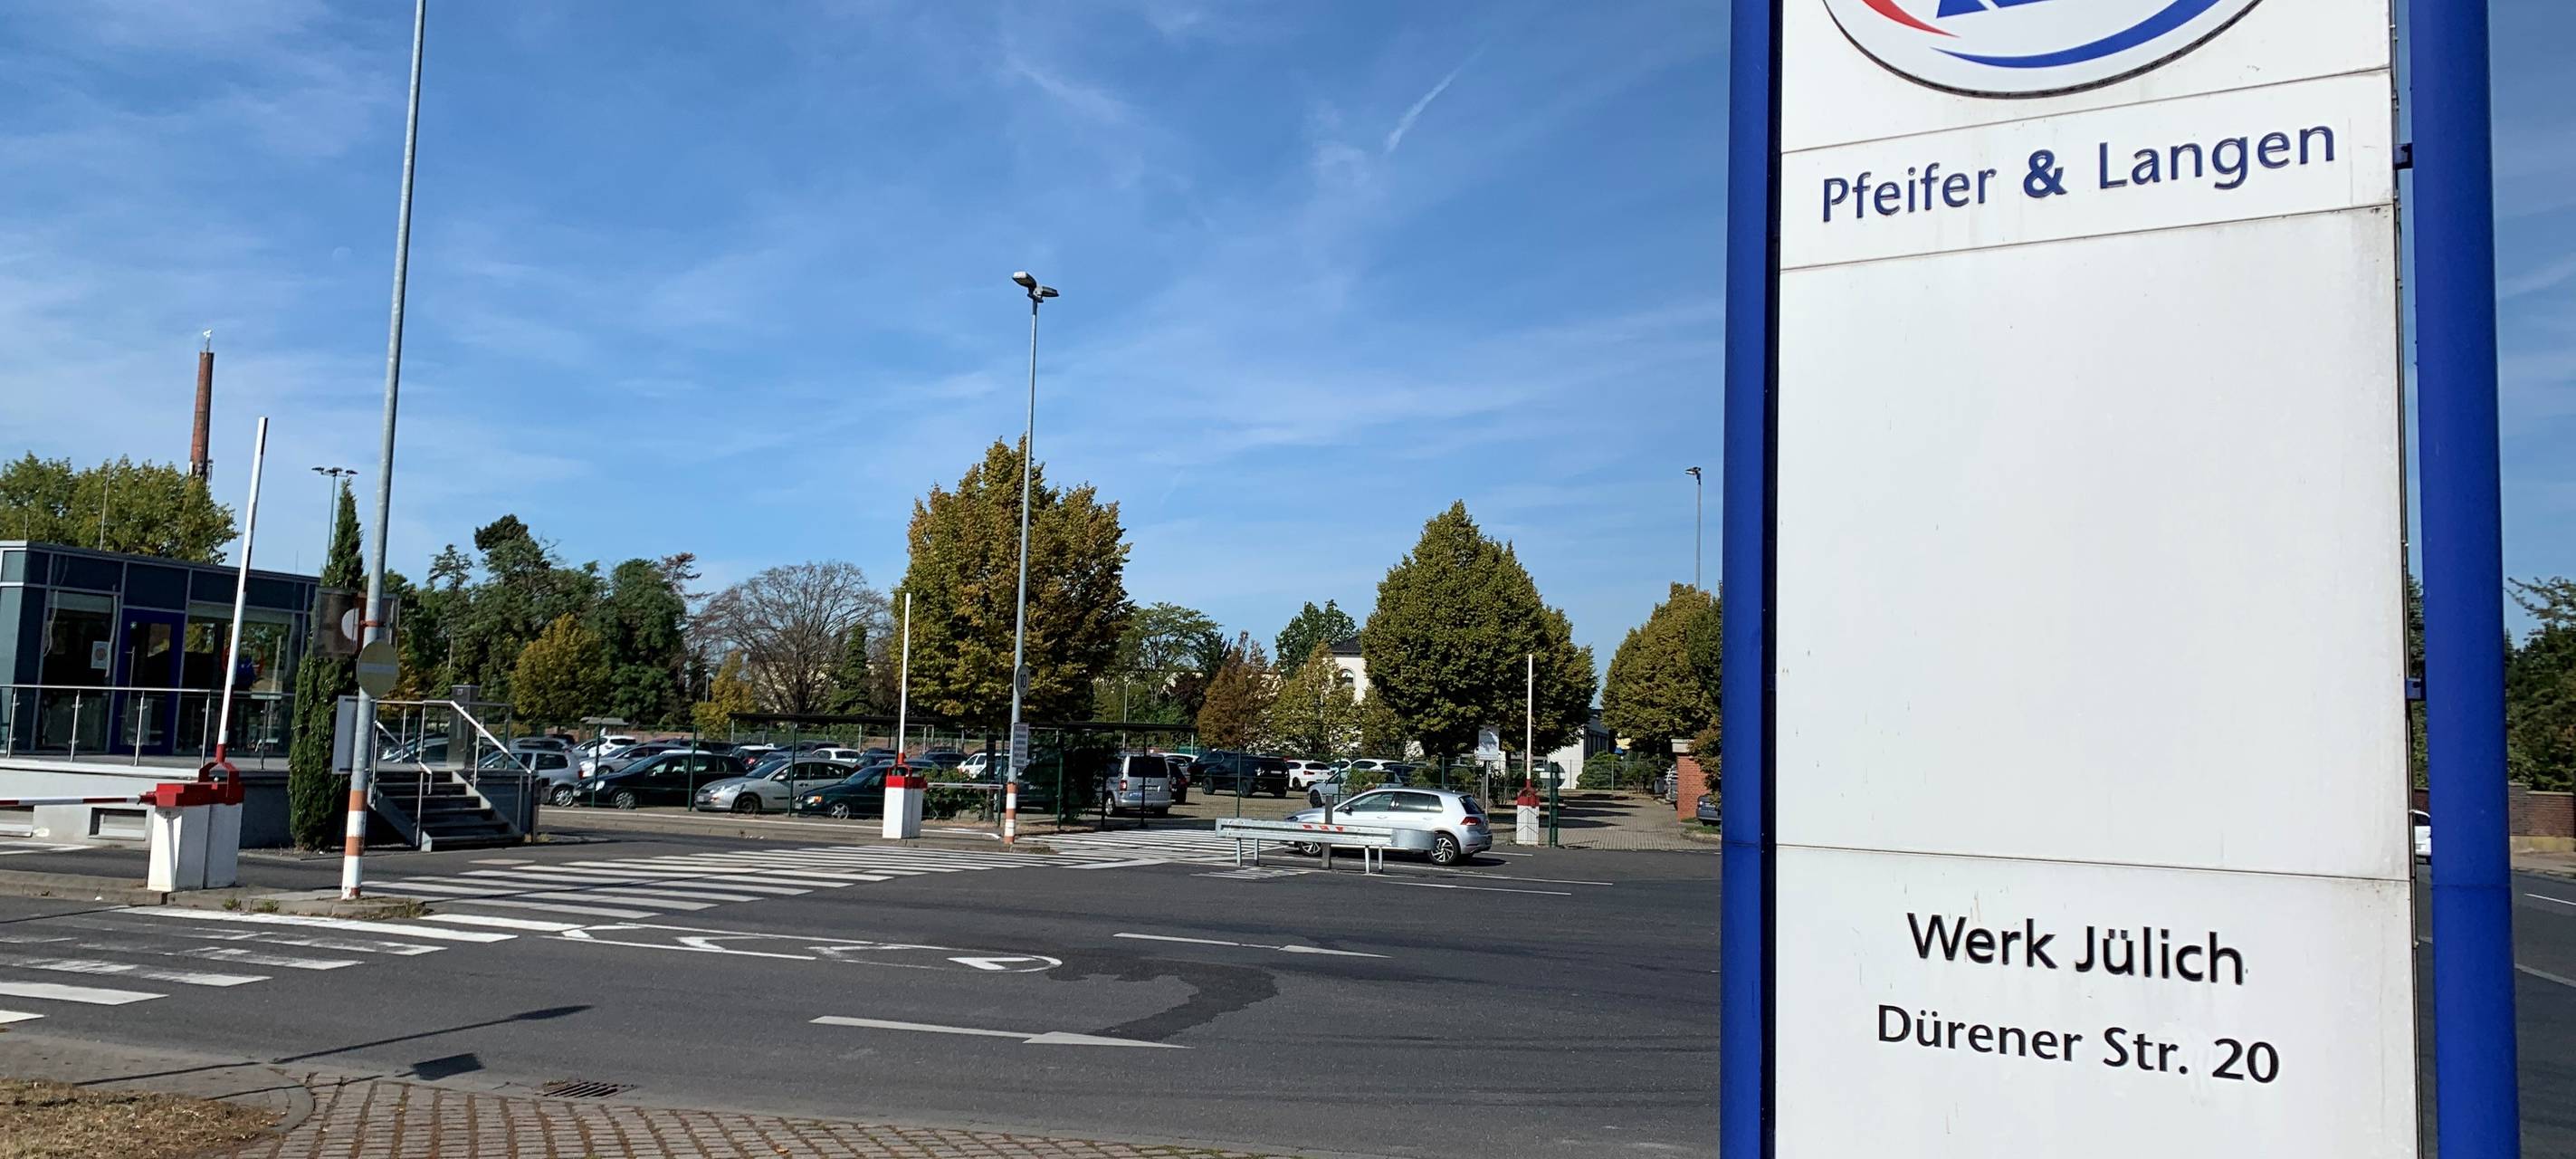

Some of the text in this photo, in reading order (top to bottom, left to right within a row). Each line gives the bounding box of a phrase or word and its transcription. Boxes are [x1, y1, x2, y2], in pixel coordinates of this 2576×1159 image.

[1824, 126, 2334, 223] Pfeifer & Langen
[1020, 674, 1027, 688] 10
[1906, 913, 2244, 985] Werk Jülich
[1878, 1004, 2279, 1084] Dürener Str. 20
